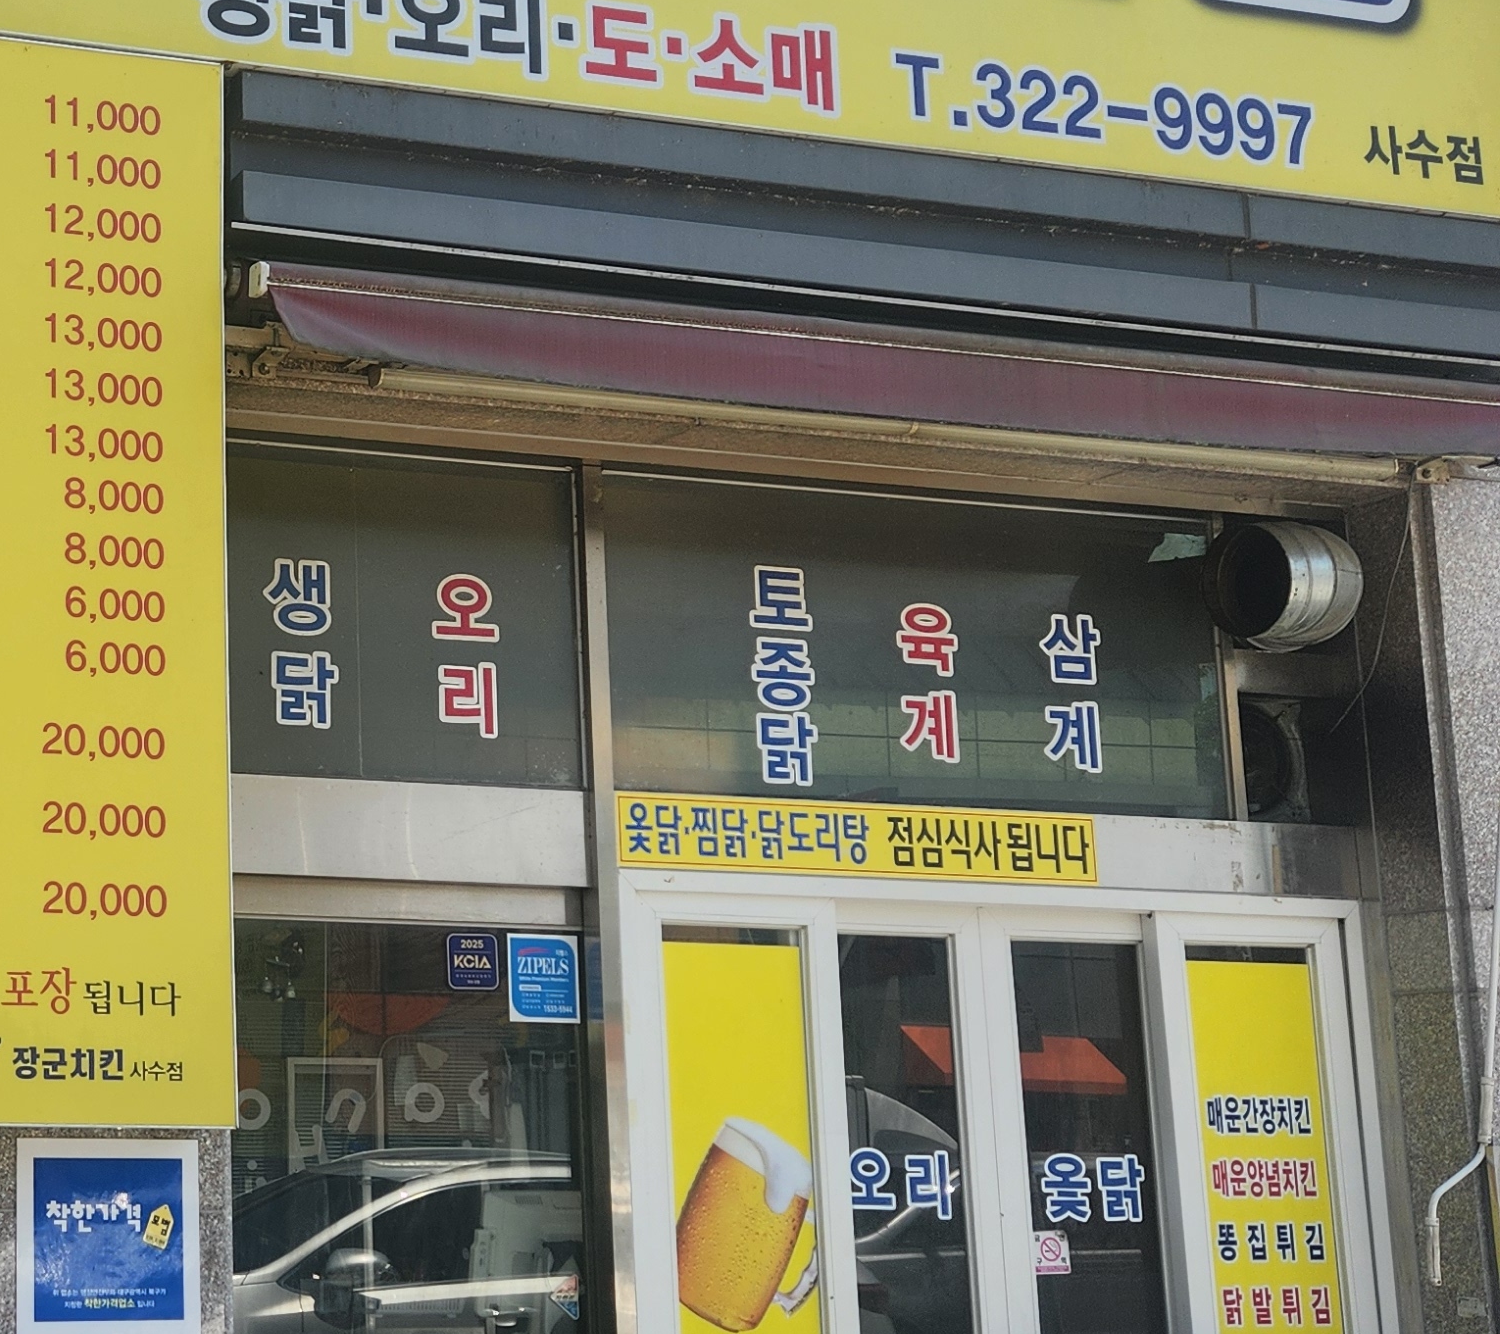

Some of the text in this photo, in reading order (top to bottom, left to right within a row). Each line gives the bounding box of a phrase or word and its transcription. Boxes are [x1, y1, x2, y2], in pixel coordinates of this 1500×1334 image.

[44, 94, 162, 136] 11,000
[895, 52, 1312, 165] T.322-9997
[1364, 125, 1485, 186] 사수점
[44, 148, 162, 190] 11,000
[44, 202, 162, 244] 12,000
[44, 257, 163, 298] 12,000
[44, 312, 163, 353] 13,000
[45, 367, 164, 407] 13,000
[45, 423, 164, 463] 13,000
[63, 476, 165, 515] 8,000
[63, 532, 165, 570] 8,000
[64, 585, 167, 624] 6,000
[65, 639, 167, 677] 6,000
[41, 722, 166, 762] 20,000
[42, 800, 167, 841] 20,000
[42, 880, 168, 922] 20,000
[453, 954, 492, 969] KCIA
[460, 939, 484, 949] 2025
[517, 956, 569, 975] ZIPELS
[1, 967, 77, 1015] 포장
[83, 980, 182, 1017] 됩니다
[12, 1047, 125, 1081] 장군치킨
[129, 1061, 184, 1082] 사수점
[1207, 1096, 1312, 1135] 매운간장치킨
[849, 1147, 954, 1221] 오리
[1041, 1152, 1145, 1224] 옻닭
[1212, 1159, 1318, 1198] 매운양념치킨
